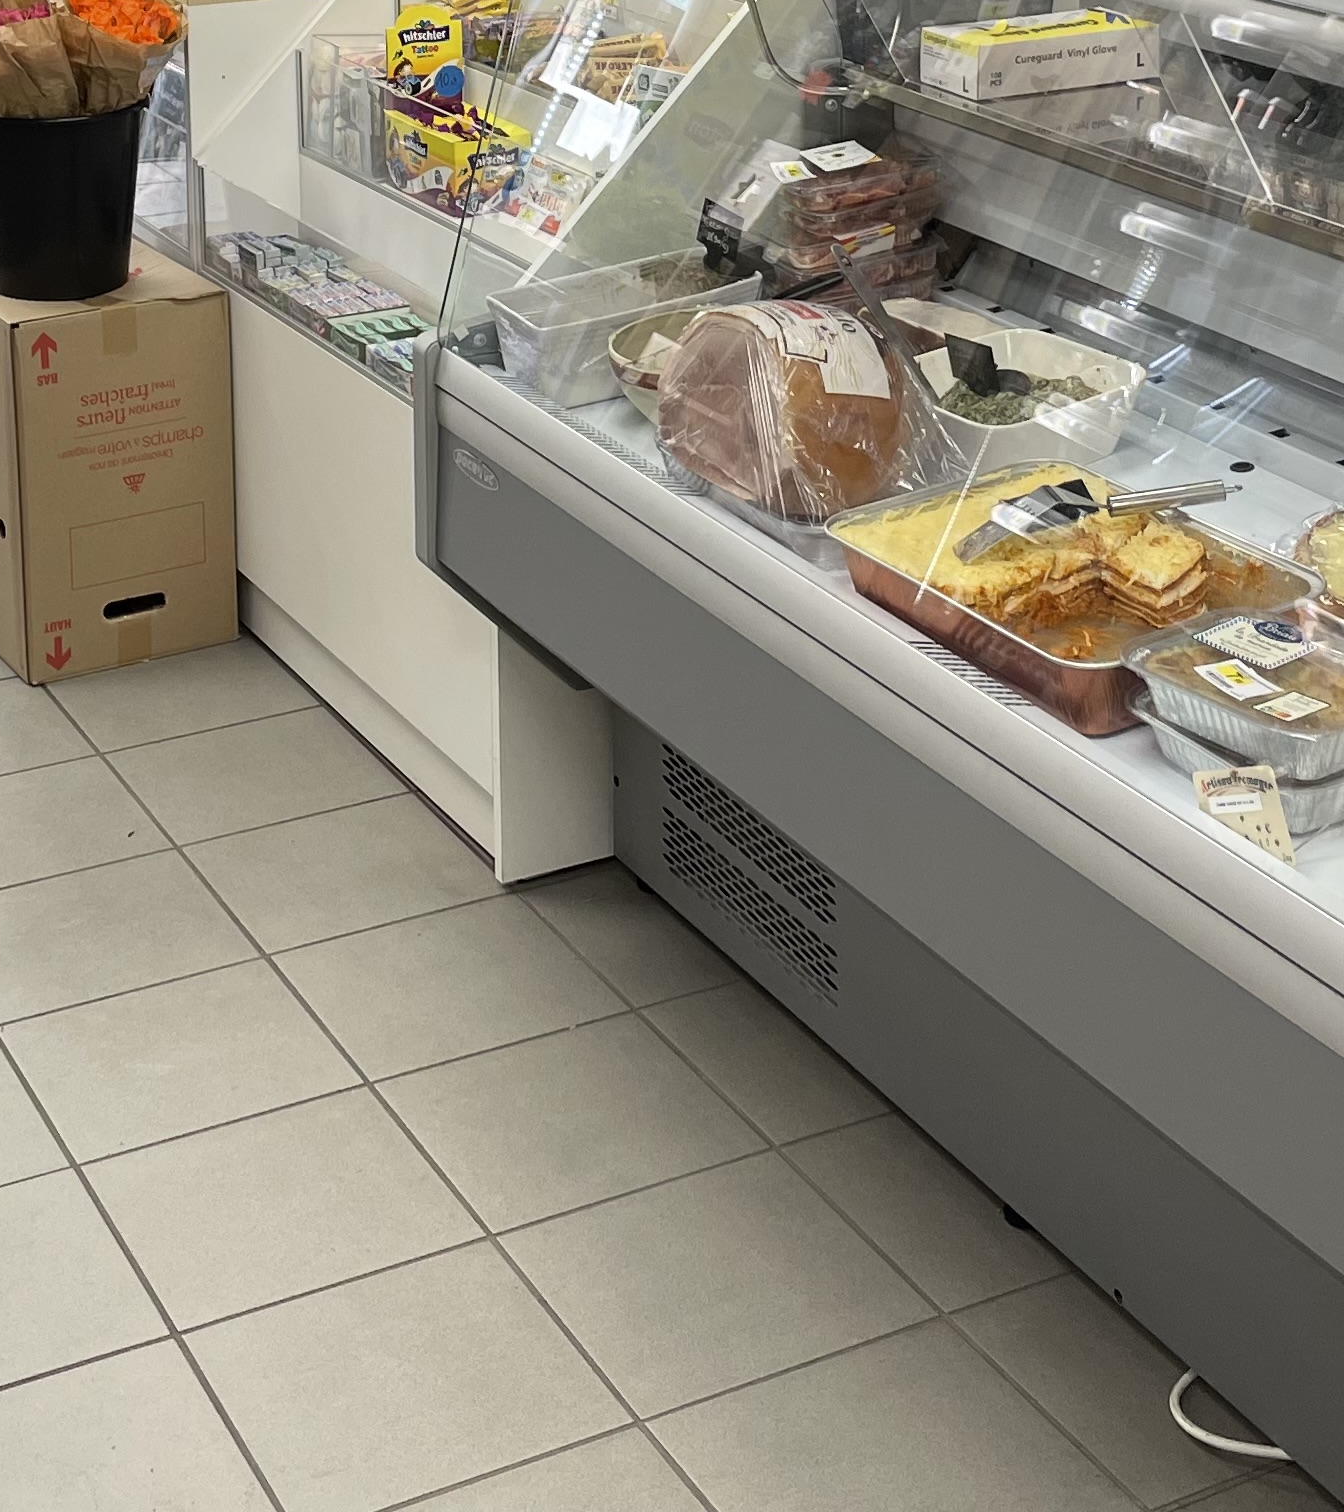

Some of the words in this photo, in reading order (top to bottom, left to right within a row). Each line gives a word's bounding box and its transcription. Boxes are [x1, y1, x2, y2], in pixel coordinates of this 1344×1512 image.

[402, 30, 446, 43] hitschler
[411, 44, 439, 54] Tattoo
[1014, 50, 1063, 65] Cureguard
[1067, 47, 1090, 59] Vinyl
[1092, 44, 1117, 56] Glove
[1136, 53, 1145, 67] L
[962, 76, 969, 93] L
[36, 373, 58, 387] BAS
[80, 383, 149, 408] fraîches
[128, 397, 181, 416] ATTENTION
[76, 407, 126, 428] fleurs
[97, 436, 132, 456] votre
[142, 425, 204, 449] champs
[44, 617, 73, 634] HAUT
